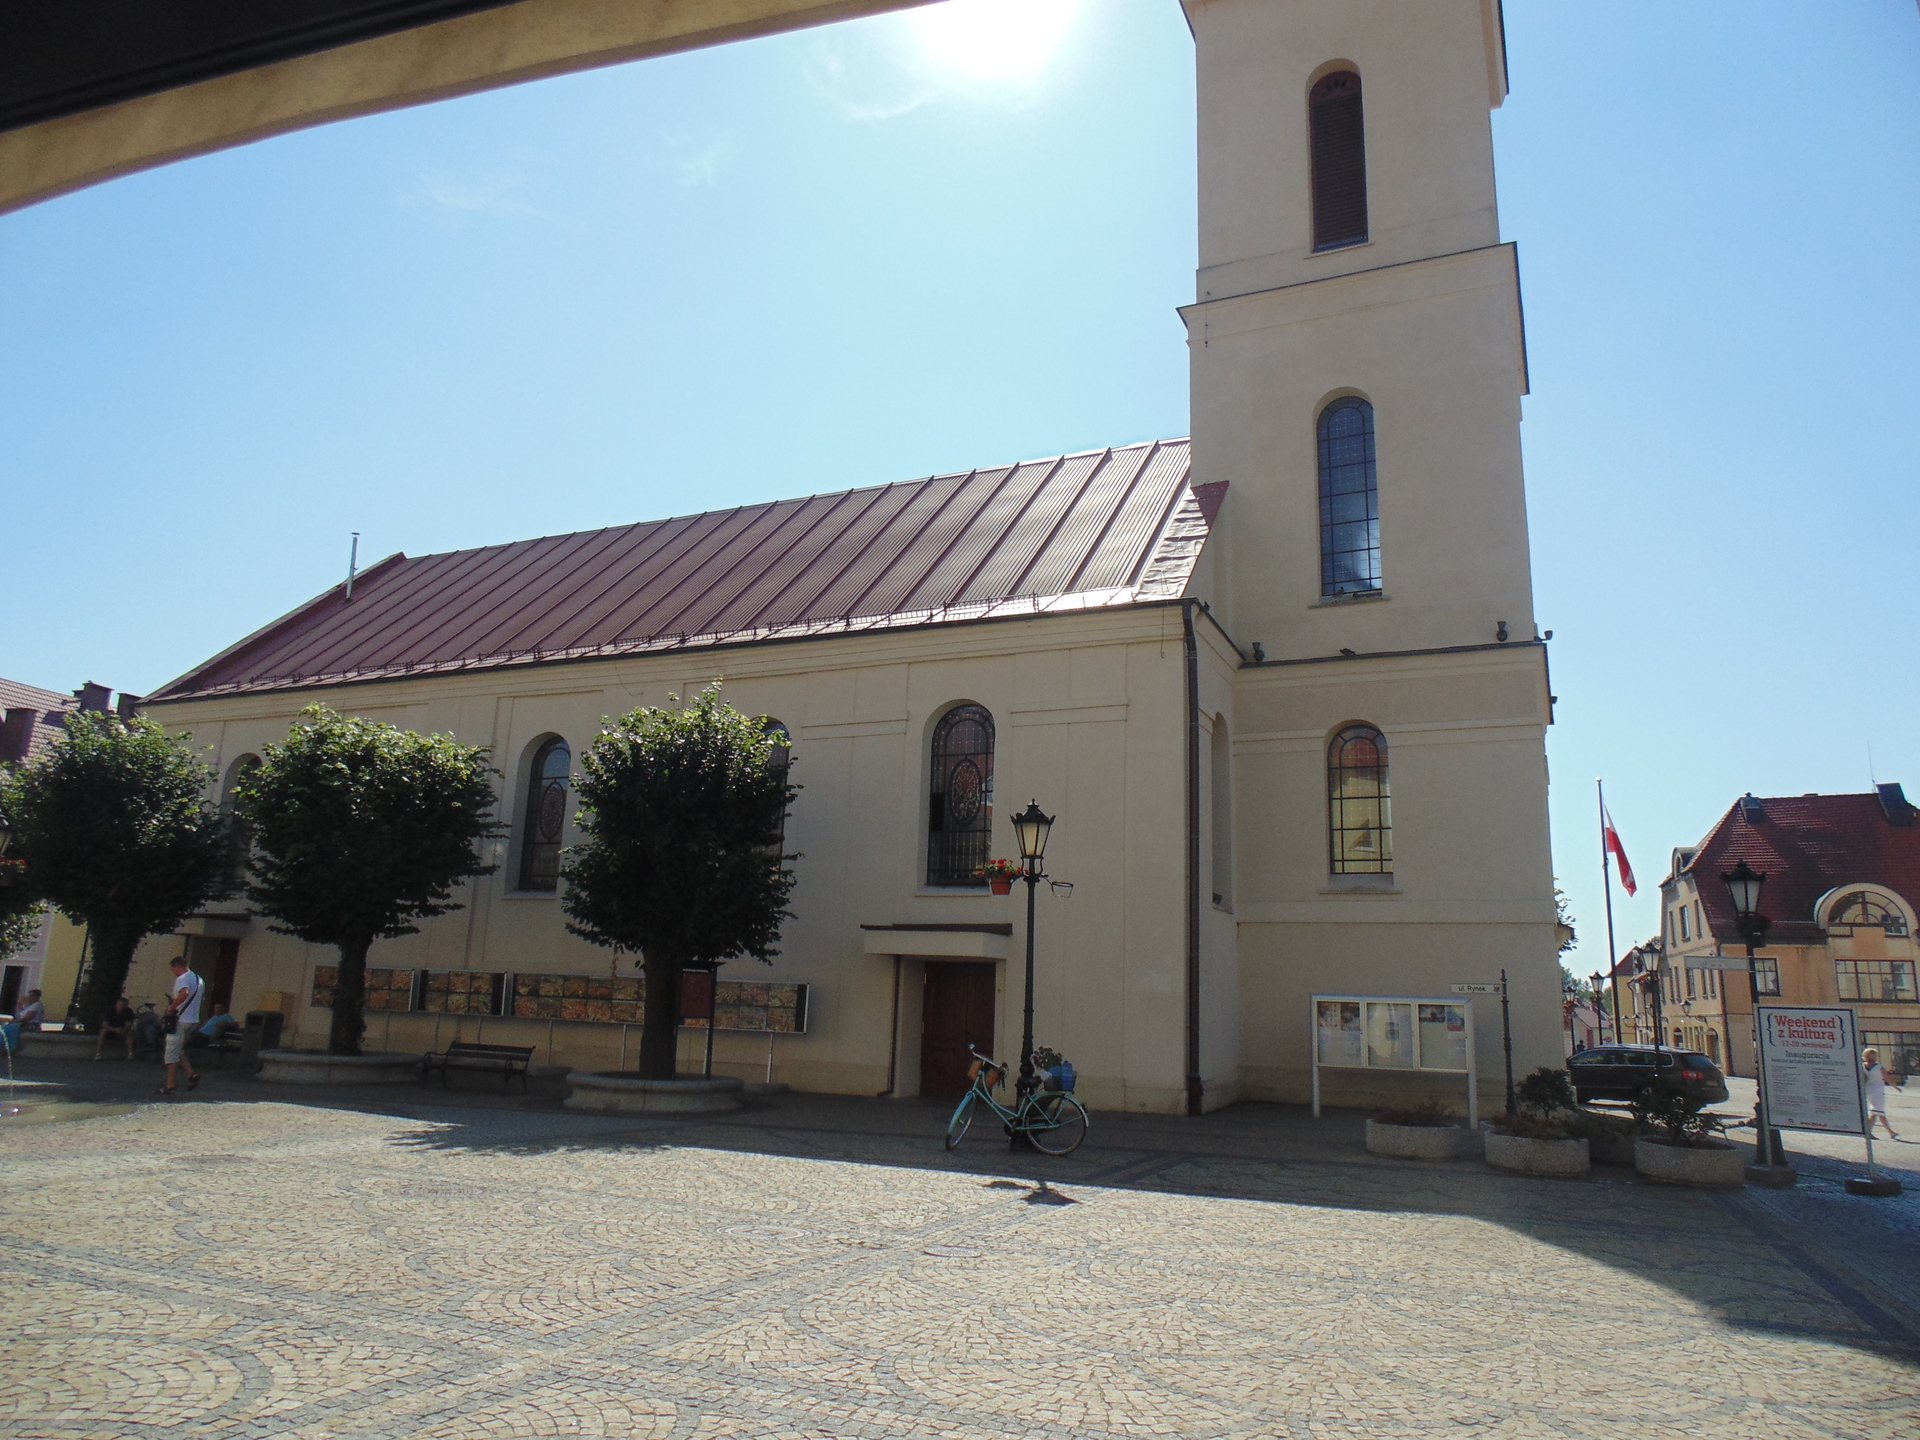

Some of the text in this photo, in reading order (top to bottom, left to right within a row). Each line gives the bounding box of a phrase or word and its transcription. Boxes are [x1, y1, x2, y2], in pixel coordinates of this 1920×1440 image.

[1467, 985, 1486, 993] Rynek
[1774, 1014, 1836, 1028] Weekend
[1778, 1028, 1836, 1042] z kulturą
